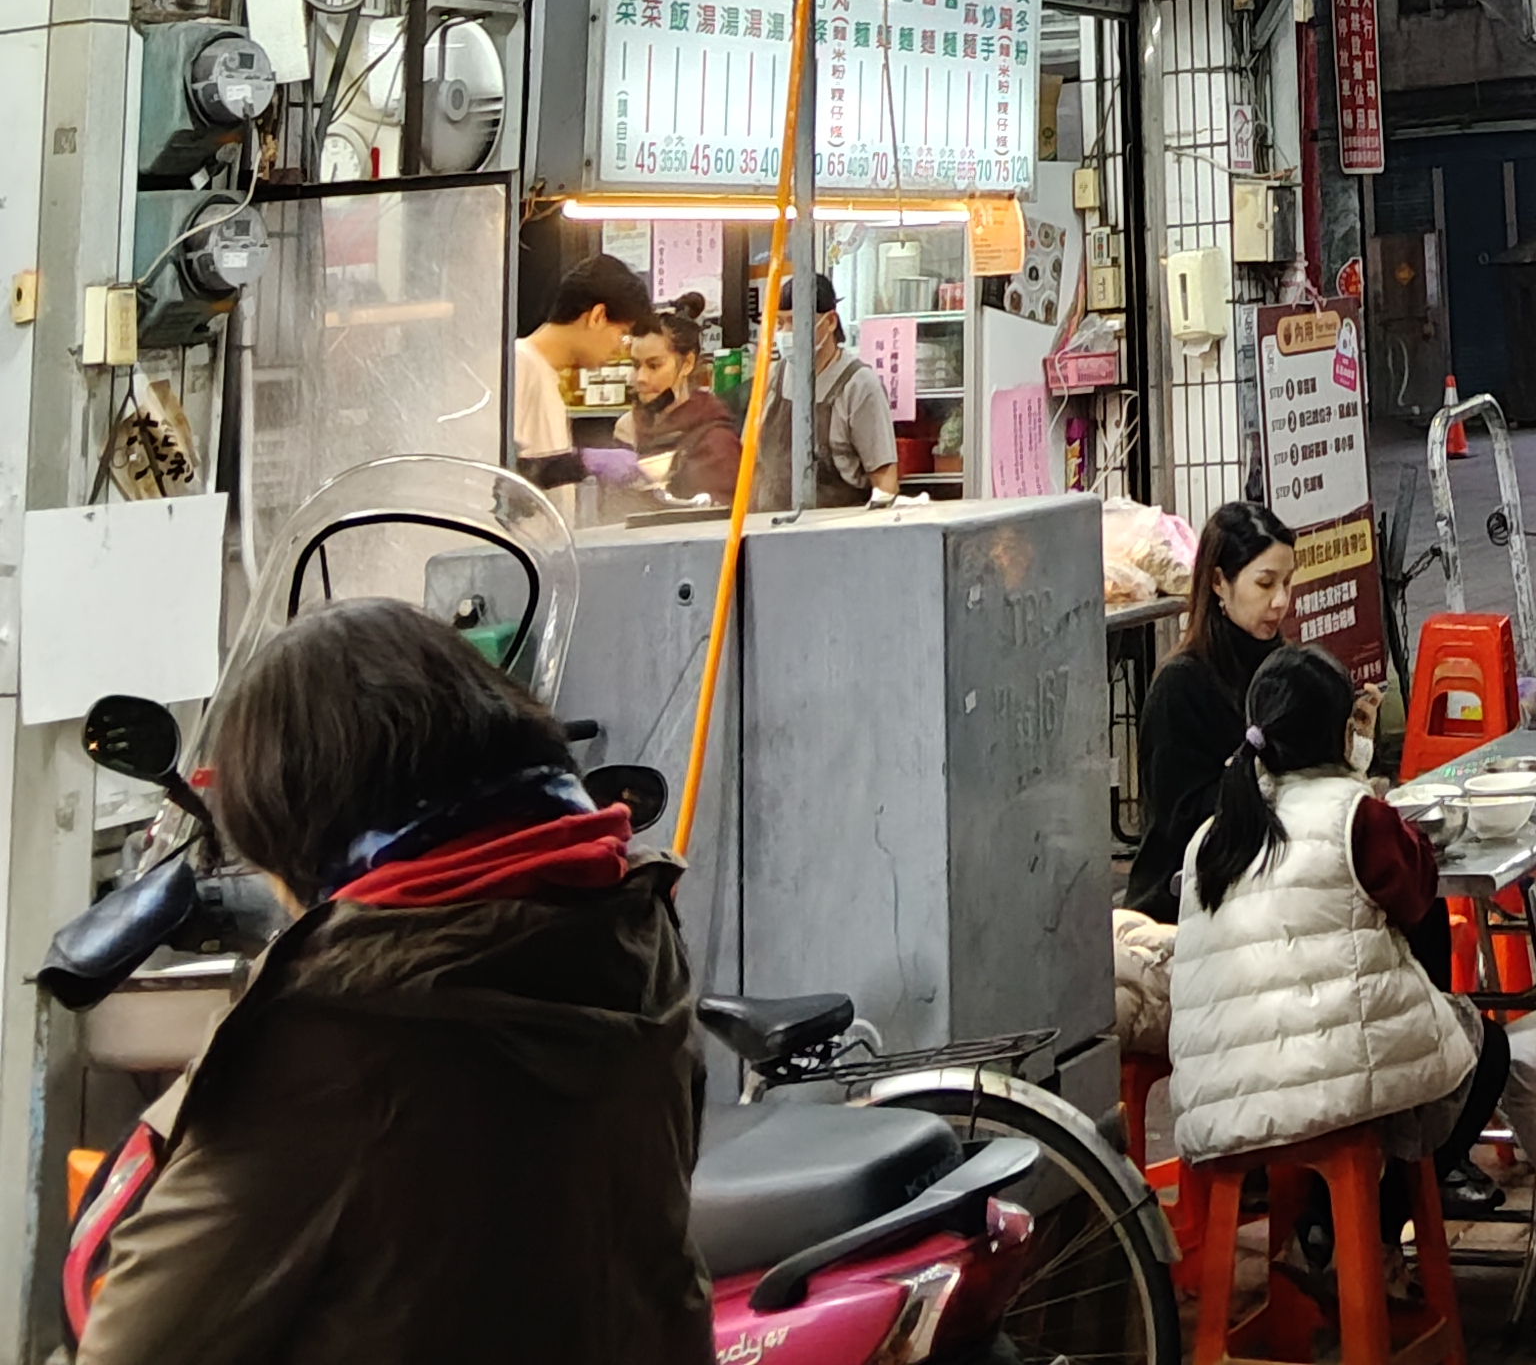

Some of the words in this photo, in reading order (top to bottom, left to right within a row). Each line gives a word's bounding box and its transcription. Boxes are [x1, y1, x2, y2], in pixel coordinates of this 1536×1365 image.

[635, 140, 657, 175] 45
[690, 143, 711, 176] 45
[714, 147, 735, 174] 60
[739, 148, 758, 174] 35
[759, 146, 780, 178] 40
[827, 152, 845, 178] 65
[872, 151, 888, 180] 70
[995, 159, 1010, 182] 75
